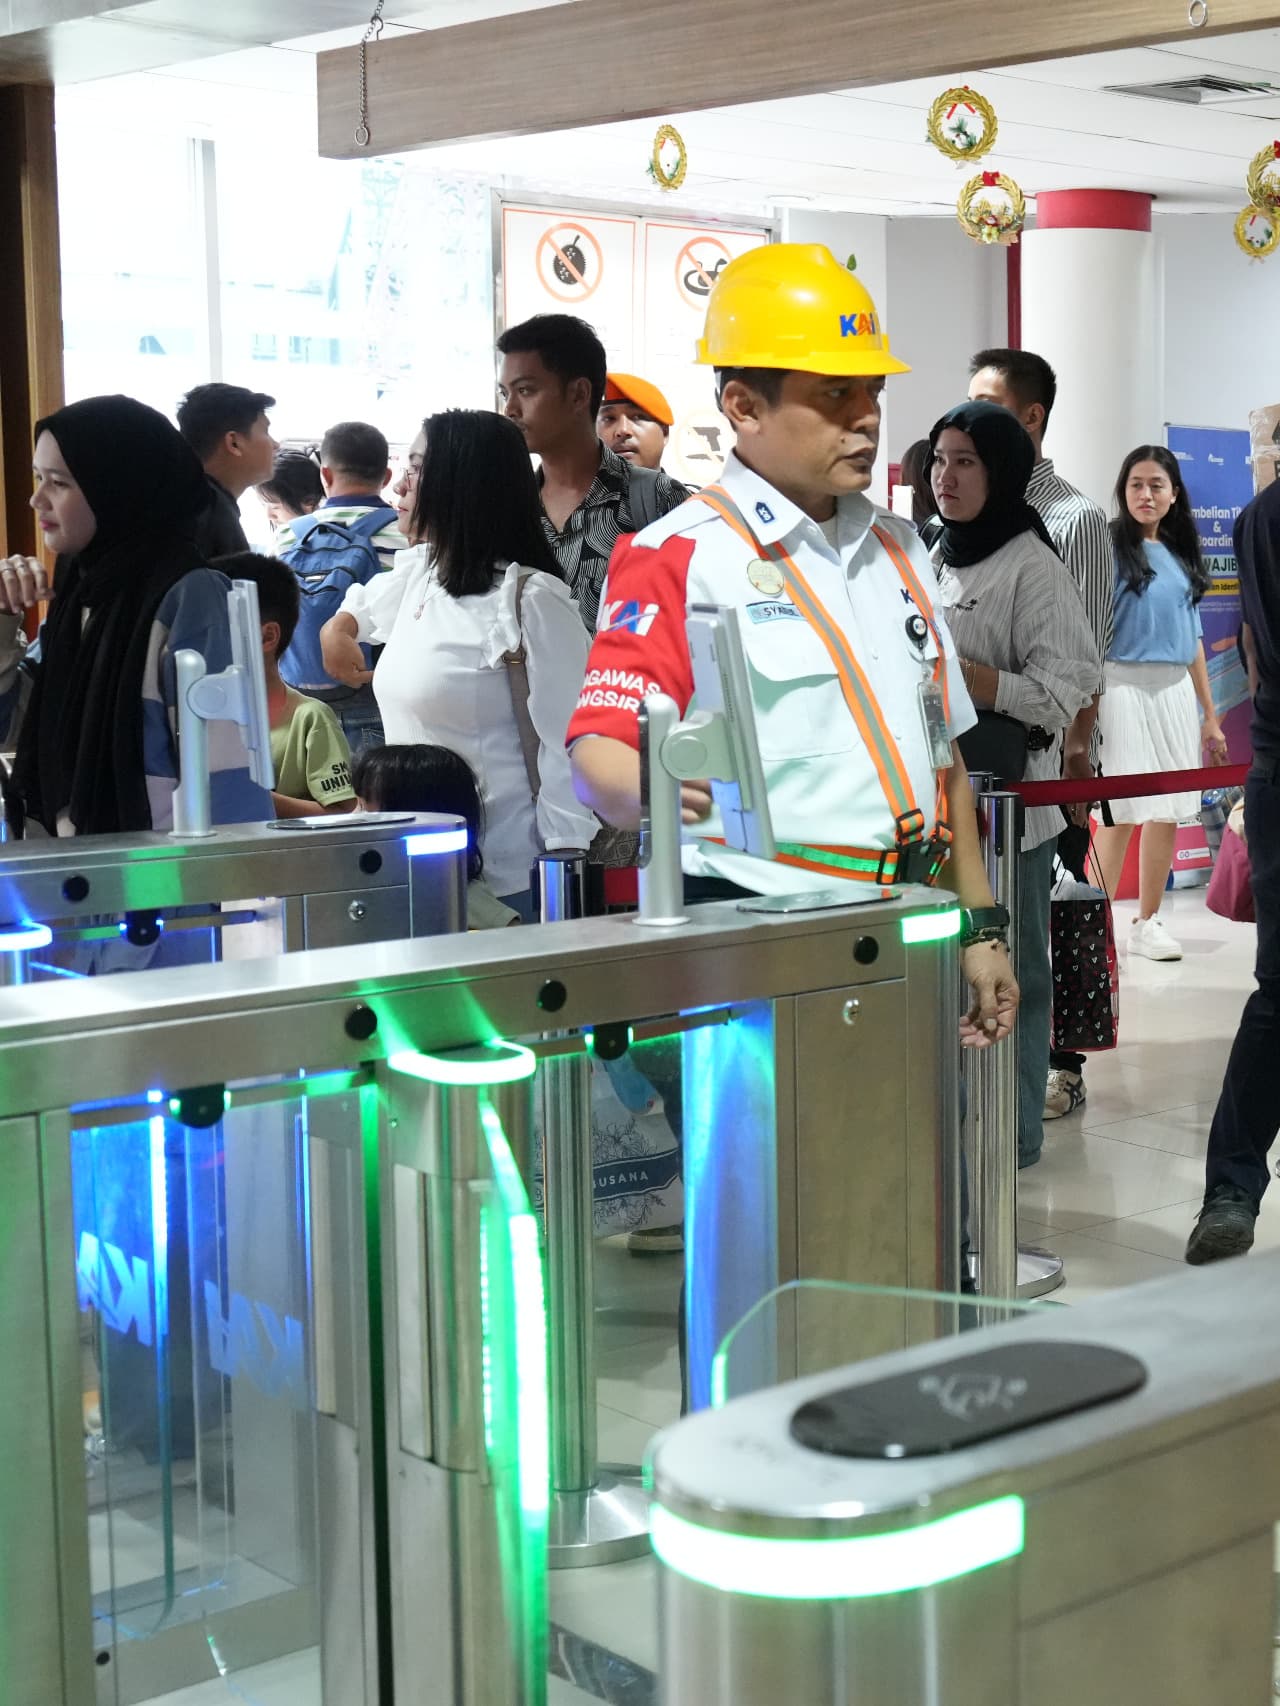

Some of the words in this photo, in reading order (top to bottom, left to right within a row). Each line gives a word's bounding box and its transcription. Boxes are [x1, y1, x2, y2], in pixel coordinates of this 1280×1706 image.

[839, 312, 876, 337] KAI
[1213, 521, 1221, 533] &
[600, 600, 660, 637] KAI
